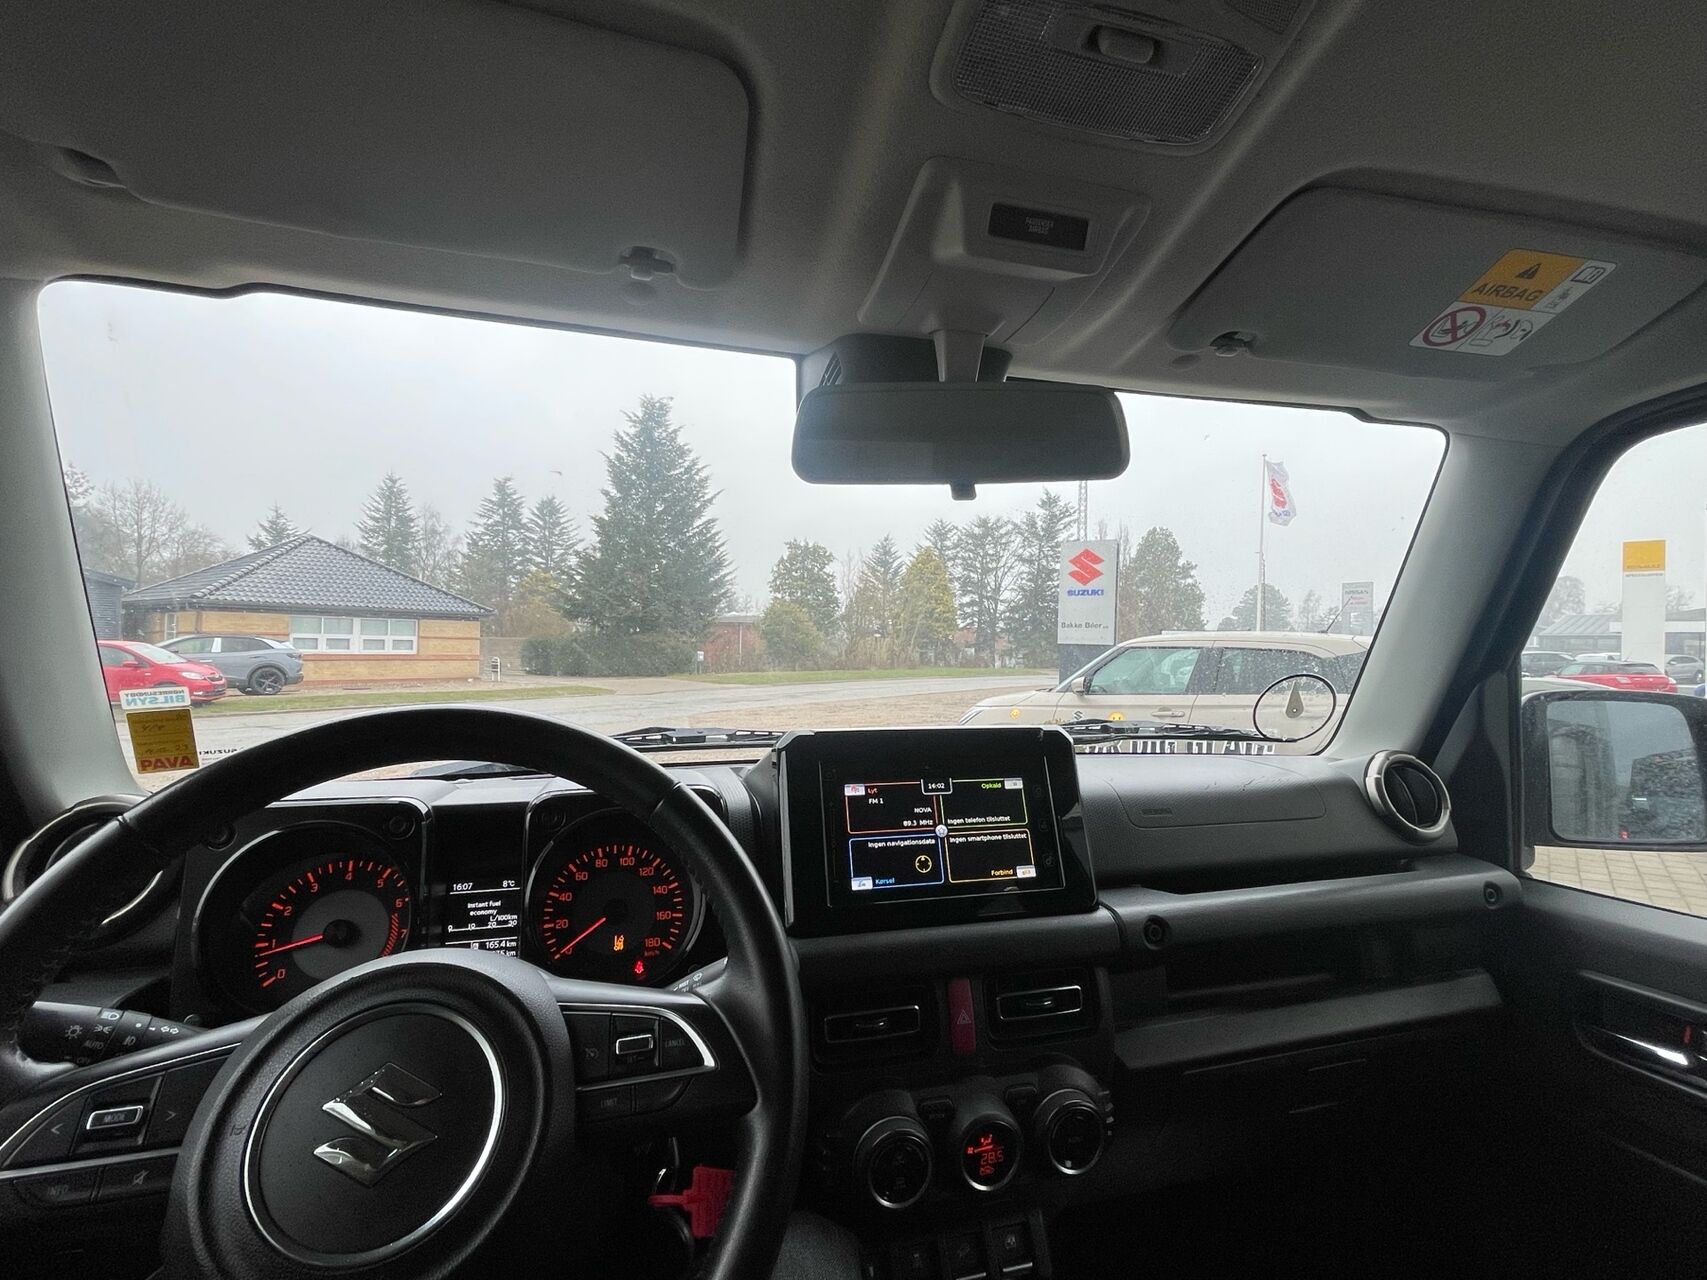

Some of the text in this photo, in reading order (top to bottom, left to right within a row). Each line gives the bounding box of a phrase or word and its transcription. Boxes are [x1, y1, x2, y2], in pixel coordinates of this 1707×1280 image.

[1472, 283, 1546, 302] AIRBAG
[1067, 588, 1104, 597] SUZUKI
[140, 755, 194, 771] PAVA
[928, 782, 945, 790] 16:02
[903, 819, 917, 827] 89.3
[965, 816, 986, 824] telefon
[986, 815, 1011, 823] tilsluttet
[887, 838, 936, 847] navigationsdata
[967, 834, 1002, 842] smartphone
[595, 859, 608, 868] 80
[619, 857, 635, 866] 100
[639, 867, 654, 876] 120
[344, 872, 352, 881] 4
[575, 872, 588, 881] 60
[875, 877, 895, 885] Kørsel
[311, 883, 318, 893] 3
[376, 879, 385, 888] 5
[652, 885, 668, 895] 140
[559, 892, 572, 902] 40
[395, 898, 403, 908] 6
[283, 906, 292, 916] 2
[656, 911, 672, 920] 160
[556, 919, 568, 929] 20
[485, 941, 505, 949] 165.4
[644, 937, 661, 947] 180
[277, 968, 286, 979] 0
[82, 1039, 104, 1049] AUTO
[981, 1150, 1004, 1165] 28.5
